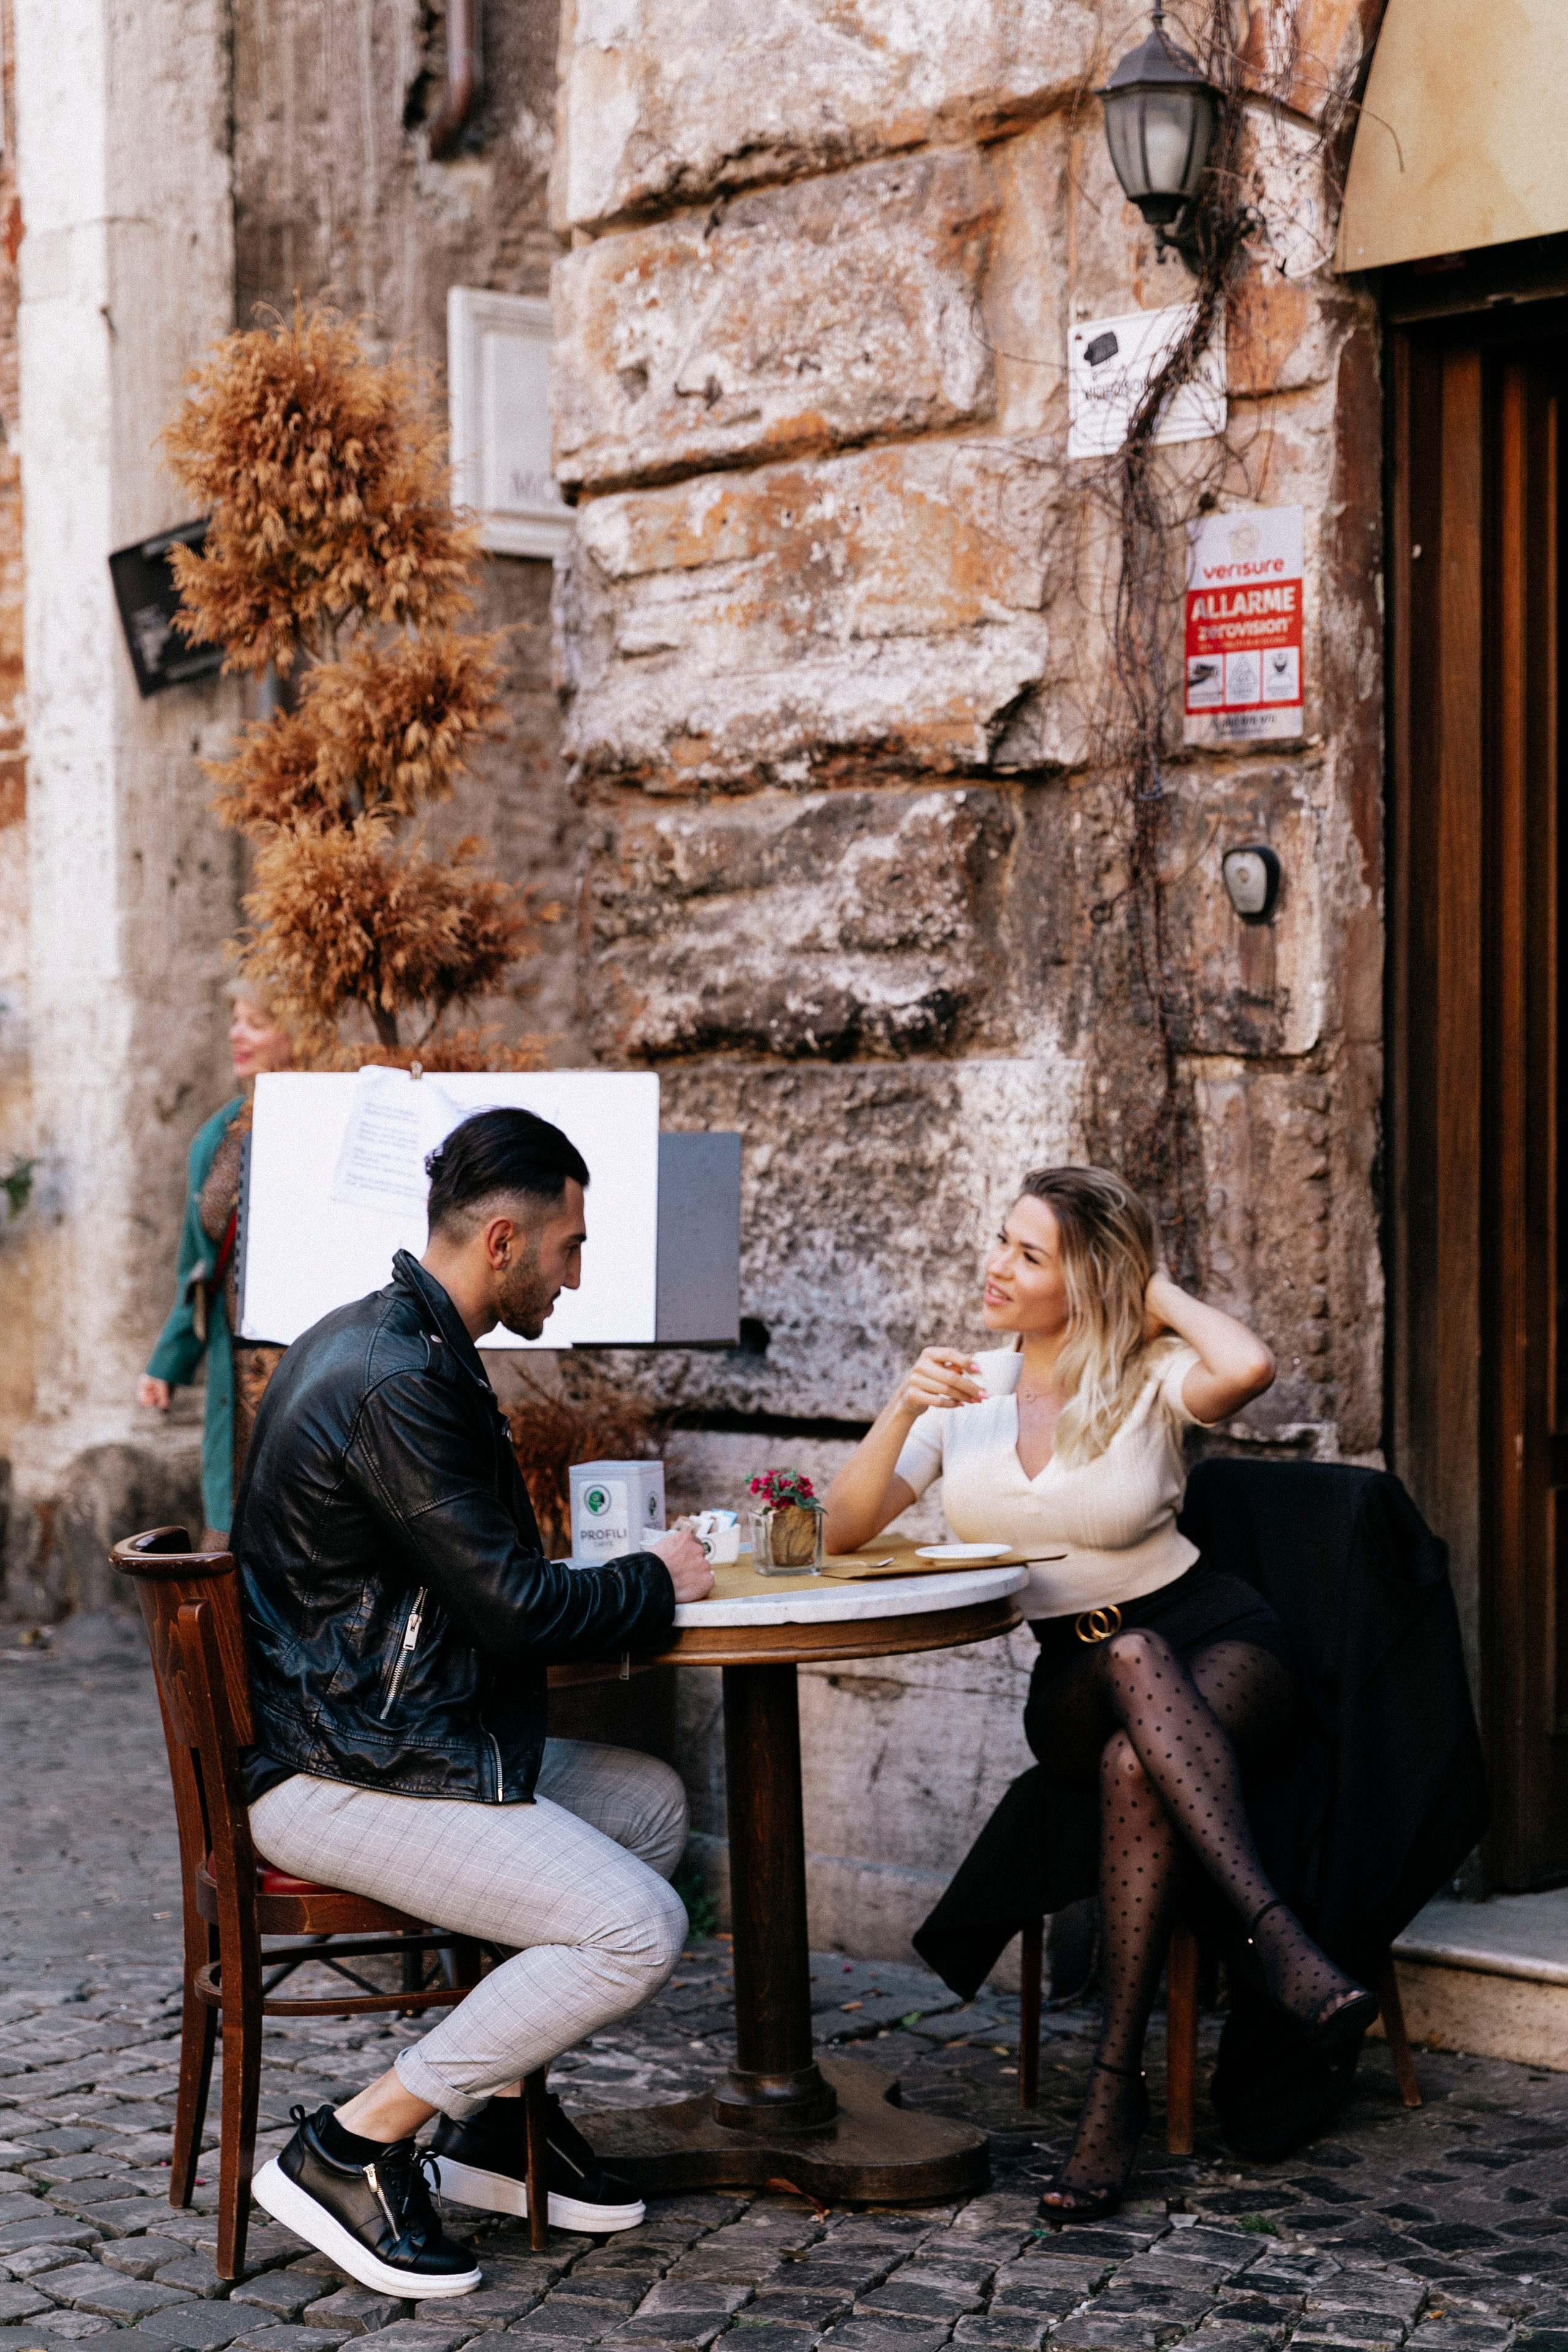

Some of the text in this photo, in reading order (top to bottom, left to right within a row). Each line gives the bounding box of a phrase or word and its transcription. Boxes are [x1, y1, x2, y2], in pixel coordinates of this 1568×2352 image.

[1202, 557, 1284, 580] verisure
[1191, 586, 1296, 622] ALLARME
[581, 1528, 627, 1540] PROFILI
